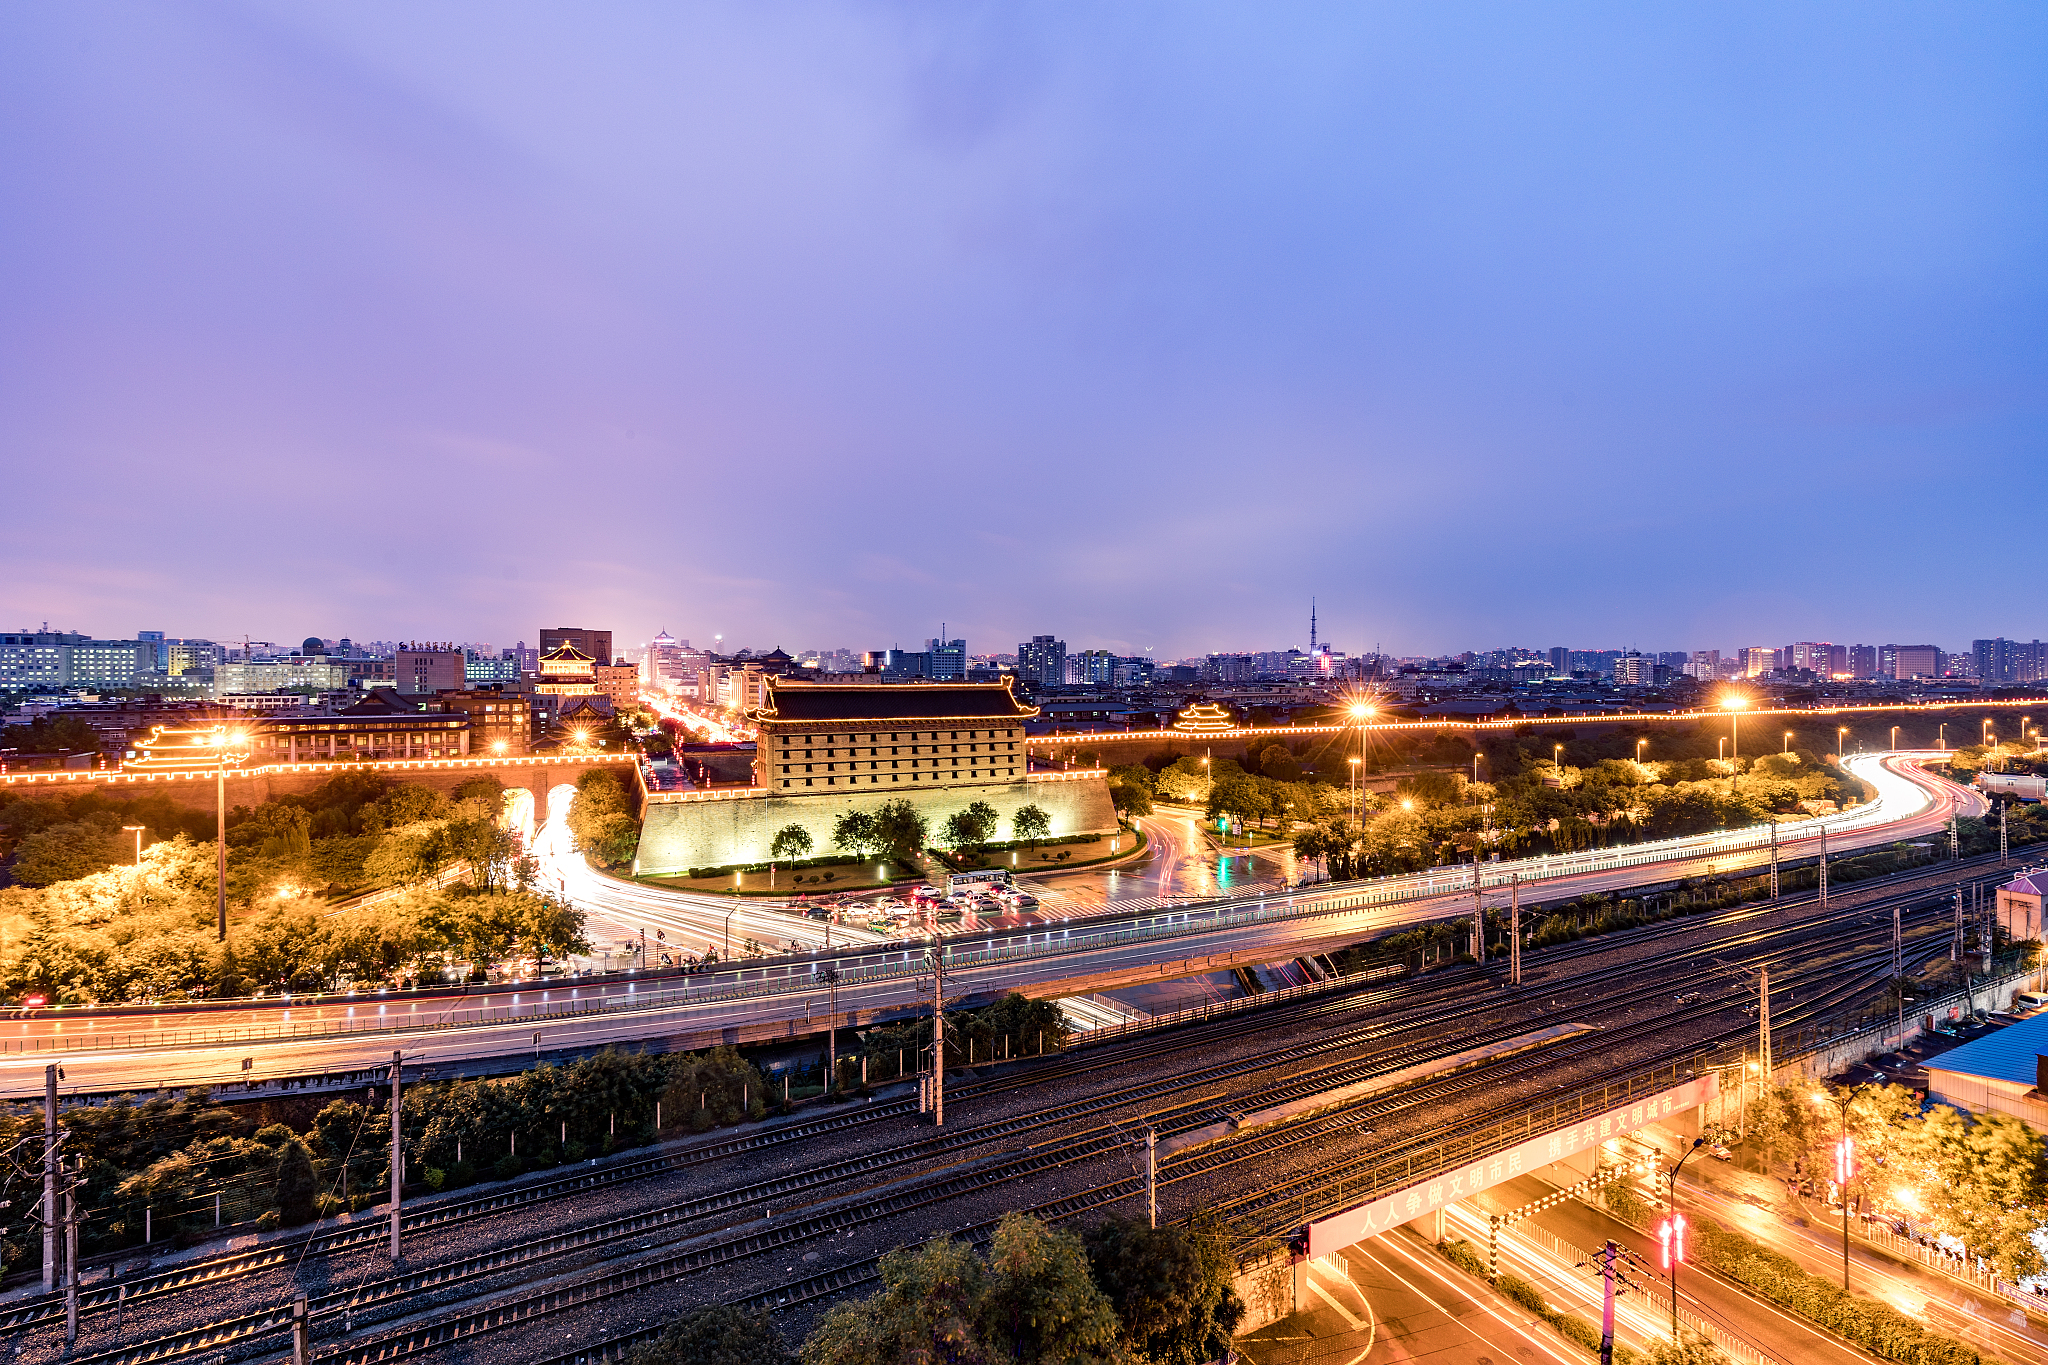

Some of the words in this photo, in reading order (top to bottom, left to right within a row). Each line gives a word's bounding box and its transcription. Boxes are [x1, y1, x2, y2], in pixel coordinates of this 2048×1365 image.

[1360, 1151, 1522, 1234] 人人争做文明市民
[1548, 1095, 1673, 1159] 携手共建文明城市
